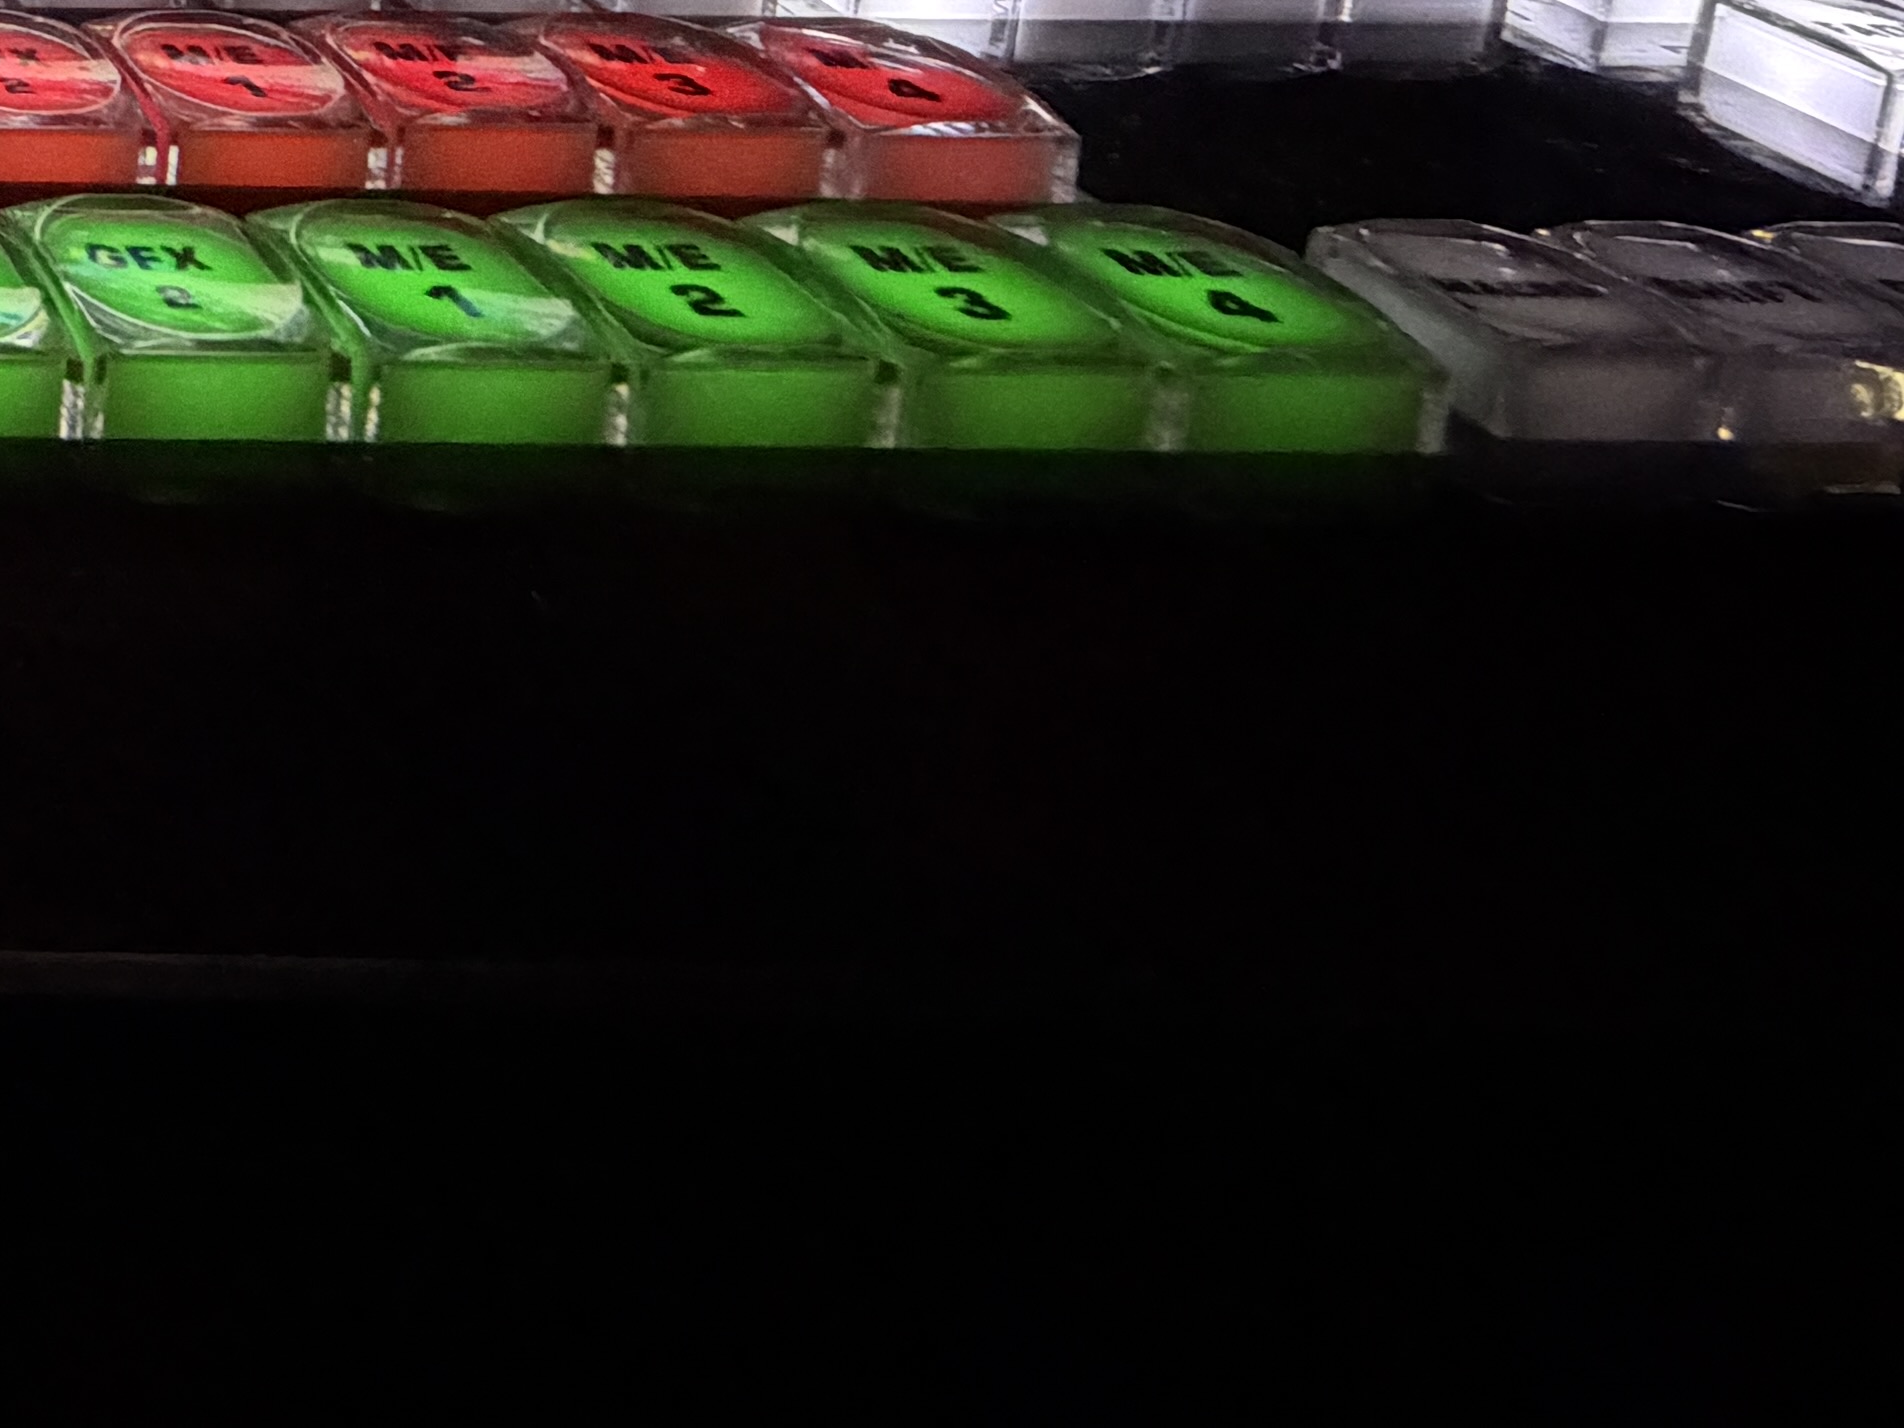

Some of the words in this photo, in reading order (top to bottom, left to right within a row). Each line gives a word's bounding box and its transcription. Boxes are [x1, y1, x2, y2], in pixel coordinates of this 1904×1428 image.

[86, 243, 213, 272] GFX
[345, 240, 475, 273] M/E
[593, 240, 725, 273] M/E
[848, 243, 988, 275] M/E
[155, 284, 203, 310] 2
[422, 283, 486, 320] 1
[669, 283, 747, 319] 2
[934, 285, 1015, 322] 3
[1204, 288, 1283, 325] 4
